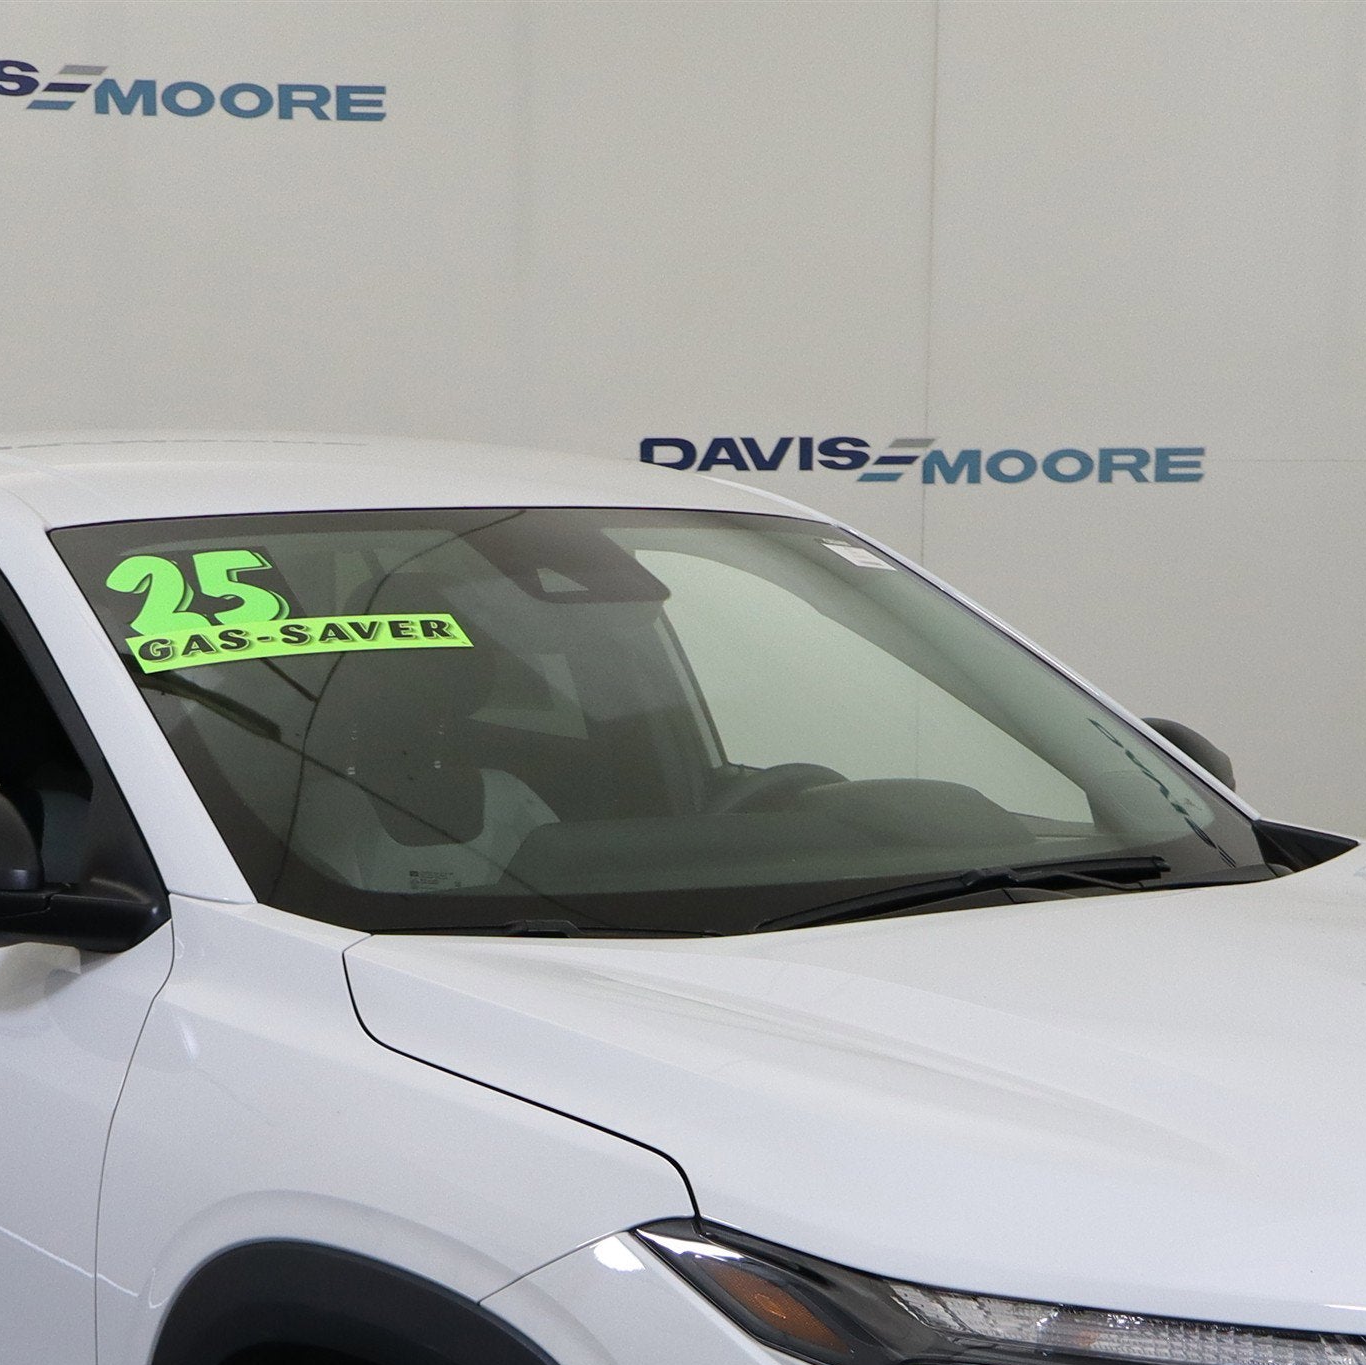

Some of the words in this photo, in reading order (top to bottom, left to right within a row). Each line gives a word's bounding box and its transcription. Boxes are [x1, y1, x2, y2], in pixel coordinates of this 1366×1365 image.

[94, 77, 387, 123] MOORE
[639, 435, 870, 472] DAVIS
[921, 446, 1205, 485] MOORE
[105, 550, 290, 636] 25
[137, 618, 456, 663] GAS-SAVER
